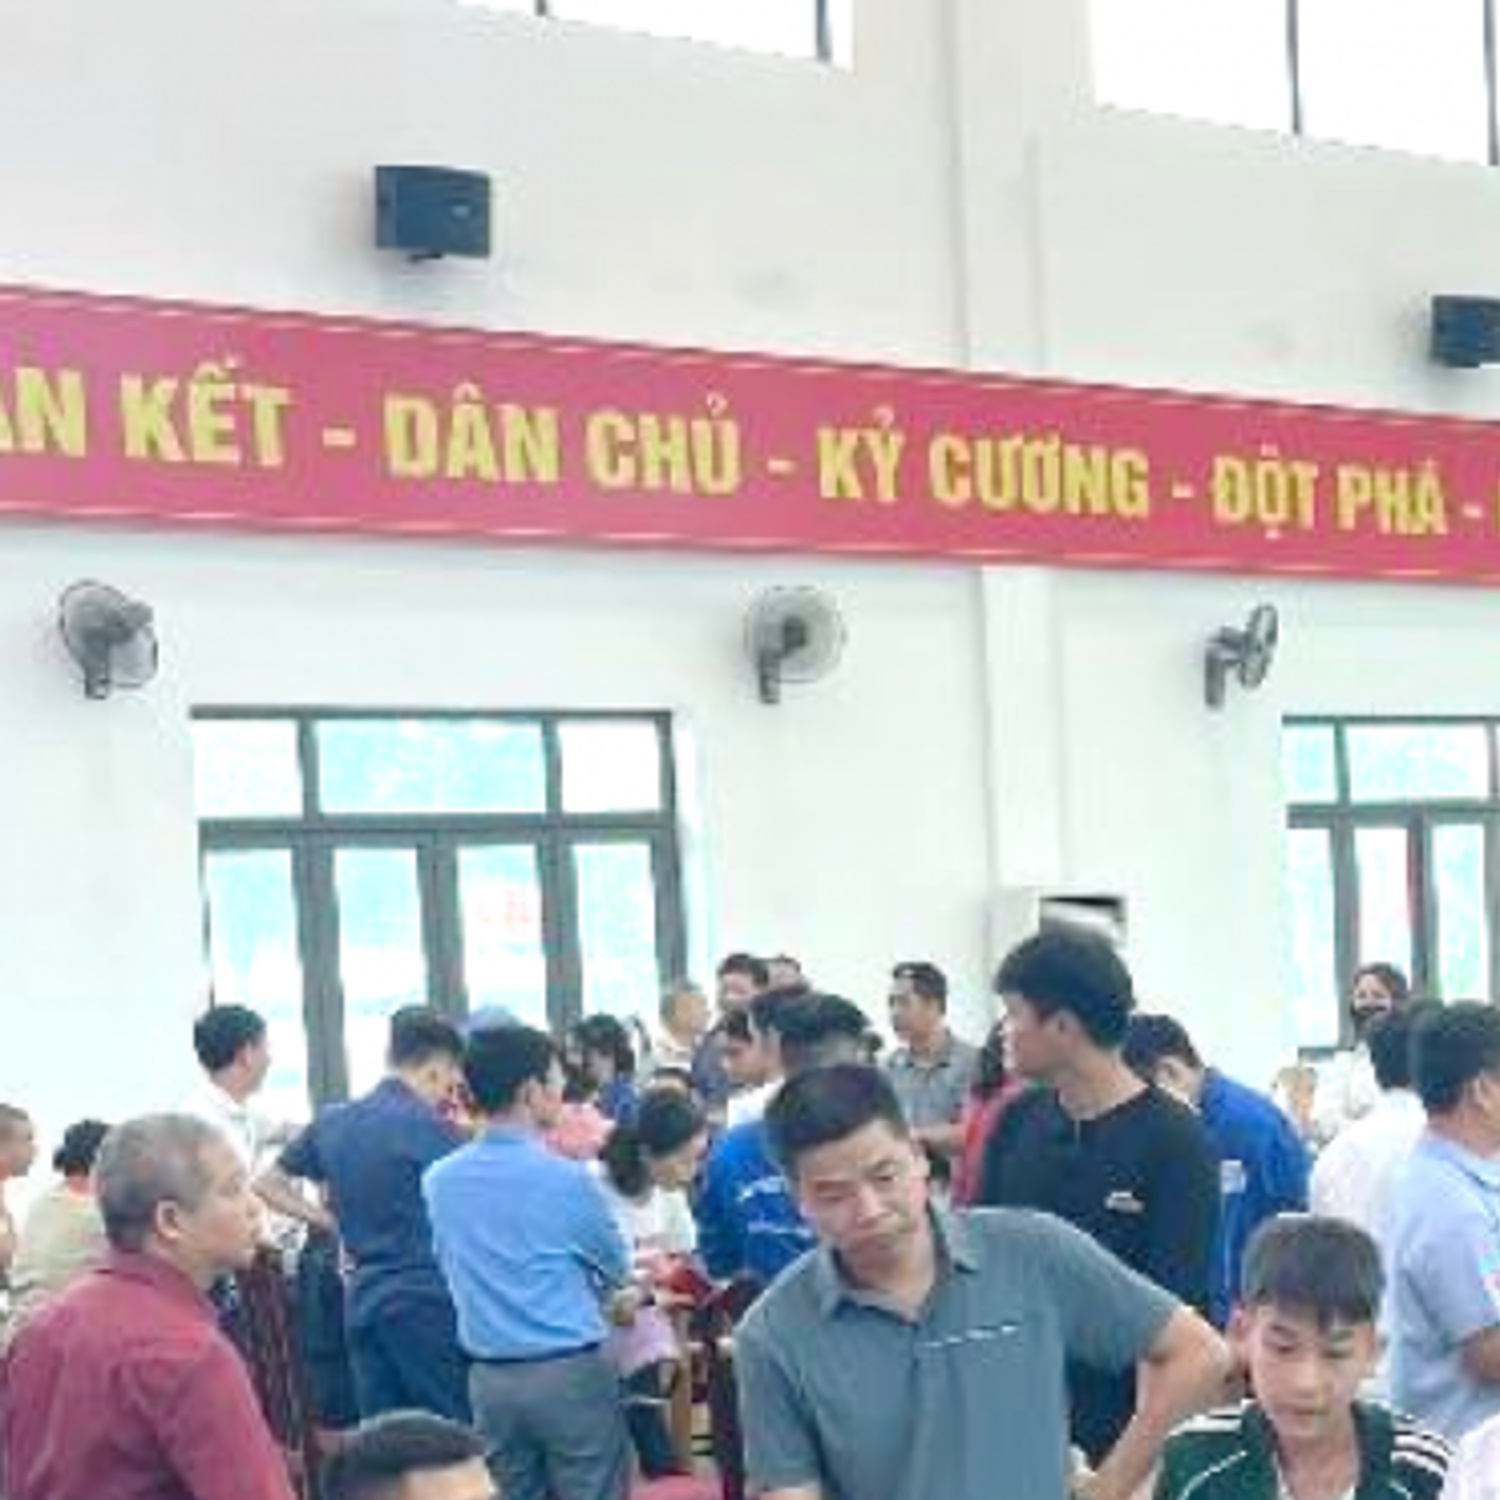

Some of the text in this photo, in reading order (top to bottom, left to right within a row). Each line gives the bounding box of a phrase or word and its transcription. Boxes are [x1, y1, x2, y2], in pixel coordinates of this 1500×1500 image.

[0, 366, 87, 458] N
[119, 354, 290, 467] KẾT
[383, 380, 560, 483] DÂN
[584, 391, 741, 494] CHỦ
[817, 406, 904, 503] KỶ
[928, 432, 1149, 518] CƯƠNG
[1211, 443, 1319, 540] ĐỘT
[1337, 458, 1448, 536] PHÁ
